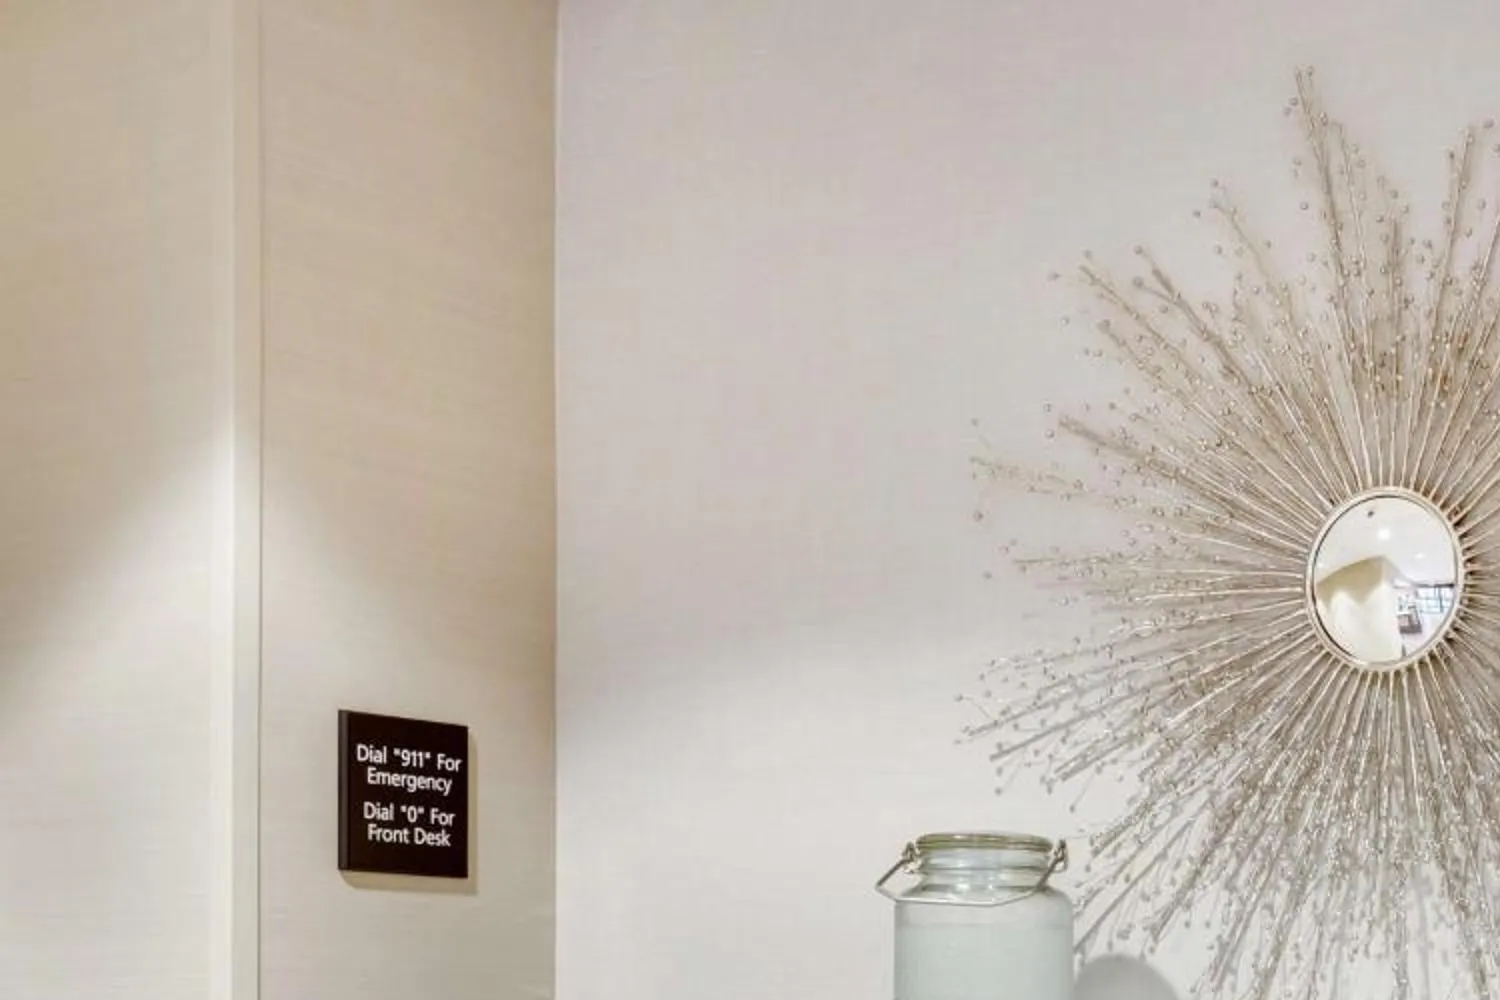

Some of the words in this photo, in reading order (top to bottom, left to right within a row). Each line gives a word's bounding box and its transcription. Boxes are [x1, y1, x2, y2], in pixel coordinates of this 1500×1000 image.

[356, 743, 388, 765] Dial
[393, 747, 431, 768] "911"
[436, 753, 463, 772] For
[367, 767, 453, 796] Emergency
[363, 801, 395, 821] Dial
[430, 808, 456, 827] For
[367, 823, 410, 845] Front
[413, 827, 452, 847] Desk
